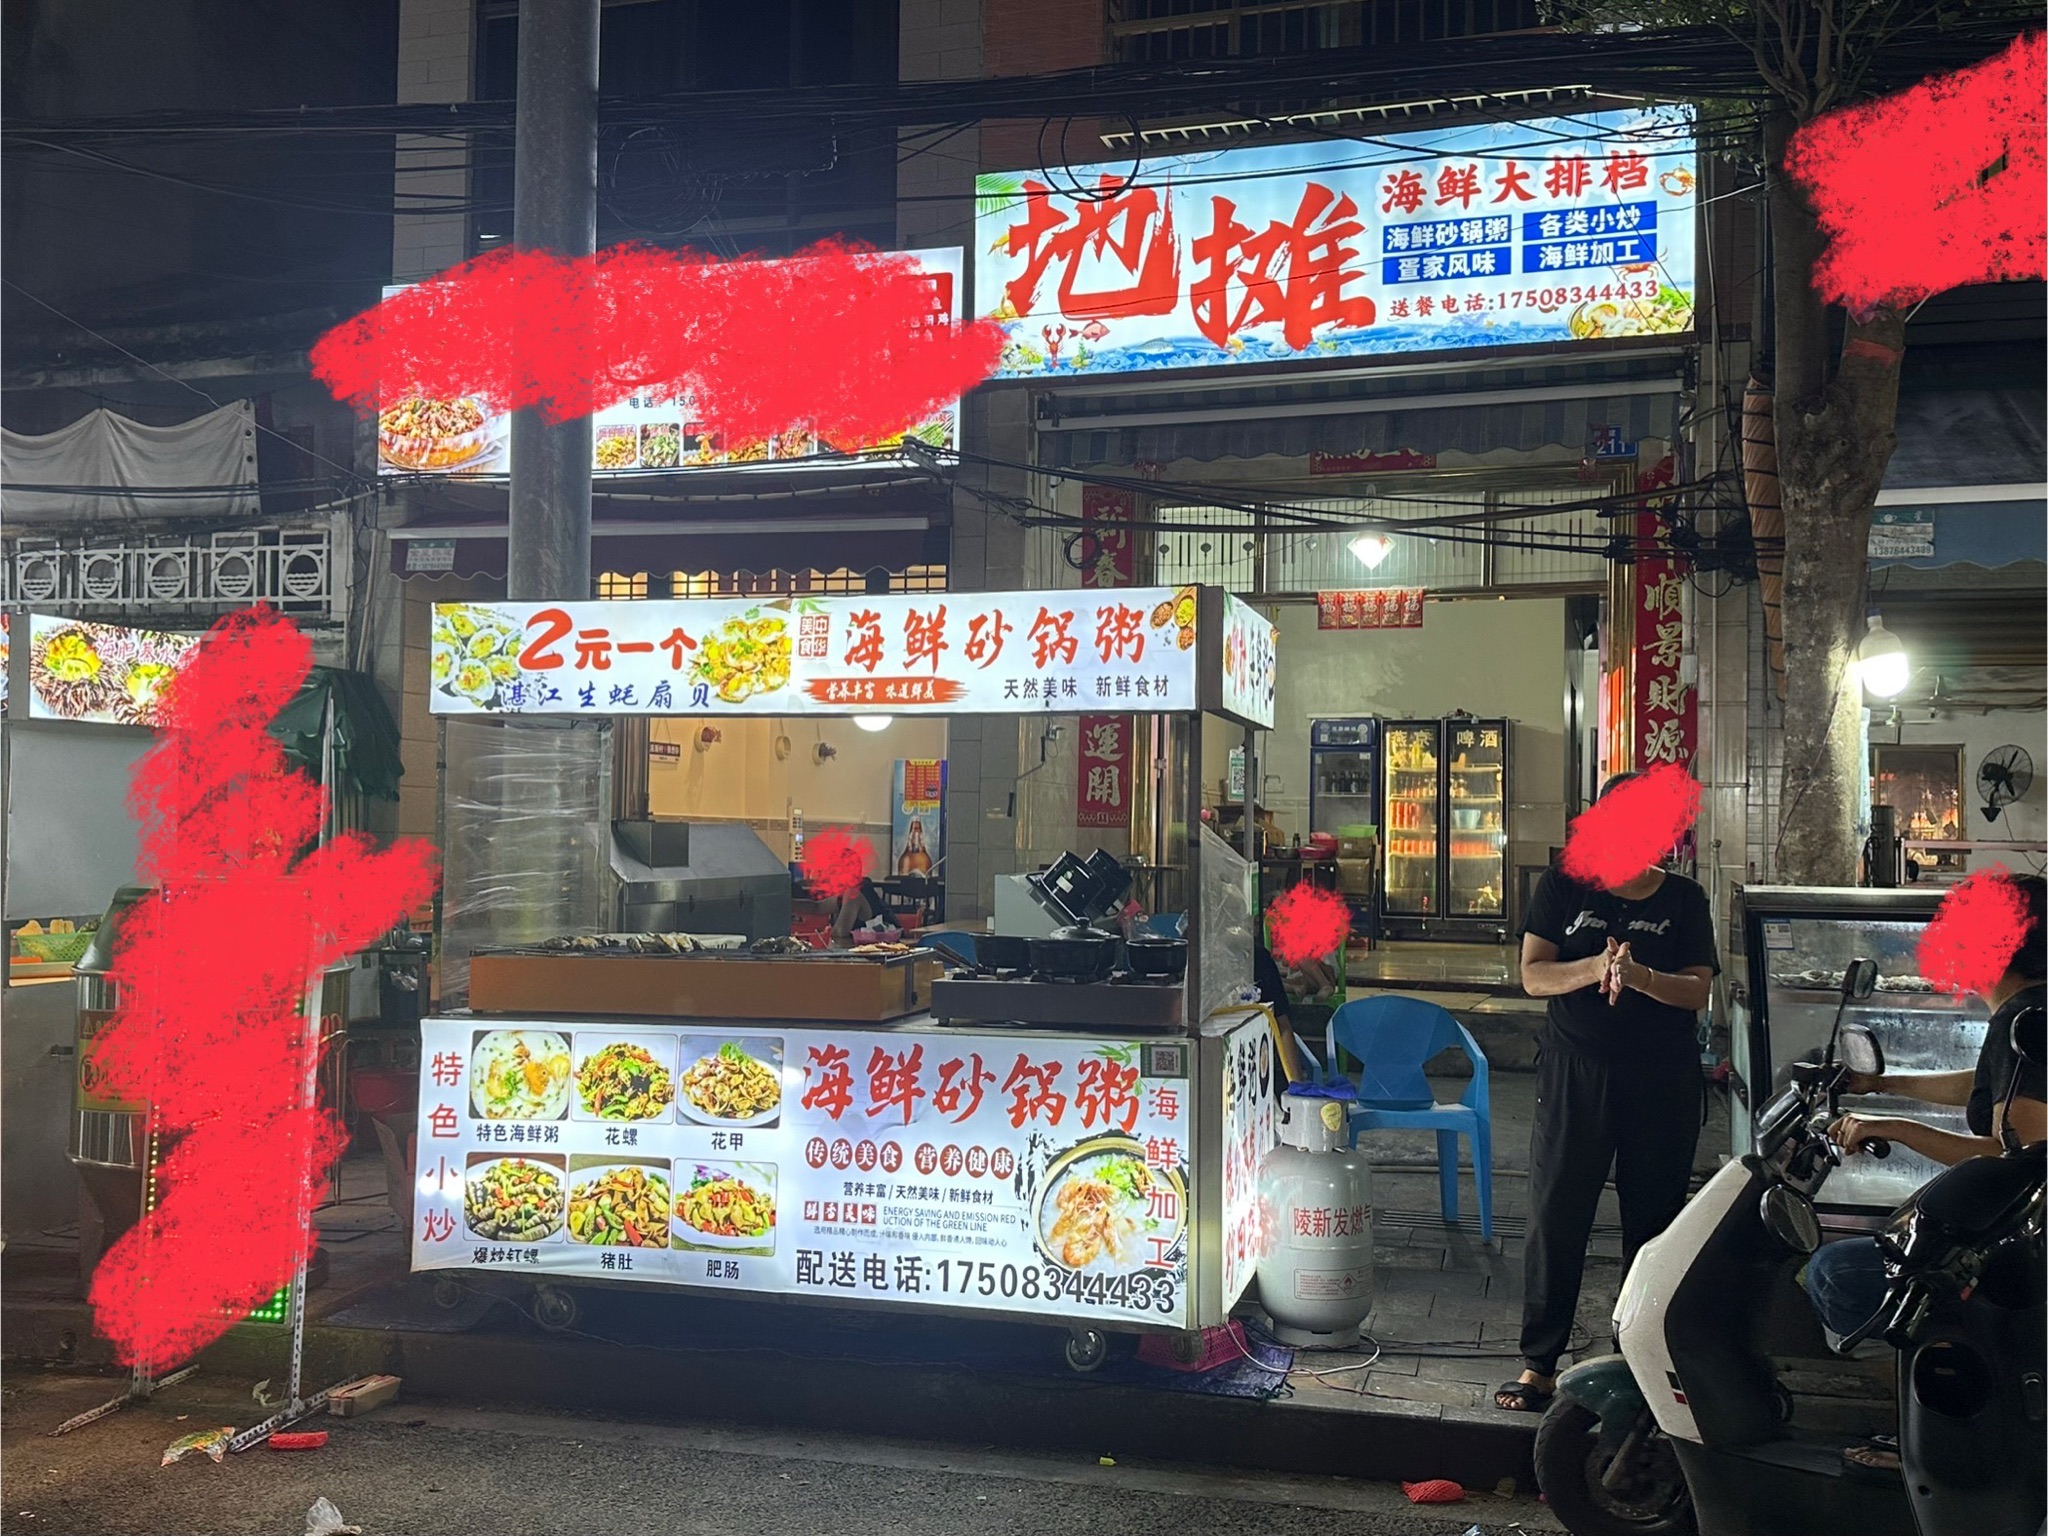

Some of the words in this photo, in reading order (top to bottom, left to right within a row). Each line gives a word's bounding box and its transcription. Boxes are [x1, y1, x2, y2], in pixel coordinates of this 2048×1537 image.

[1381, 148, 1650, 214] 海鲜大排档
[1386, 216, 1509, 252] 海鲜砂锅粥
[1538, 204, 1643, 238] 各类小炒
[1004, 172, 1377, 351] 地摊
[1538, 238, 1642, 270] 海鲜加工
[1389, 279, 1660, 320] 送餐电话:17508344433
[518, 608, 697, 670] 2元一个
[844, 602, 1146, 672] 海鲜砂锅粥
[1003, 677, 1079, 700] 天然美味
[1095, 674, 1170, 696] 新鲜食材
[1456, 730, 1498, 747] 啤酒
[801, 1042, 1141, 1133] 海鲜砂锅粥
[423, 1051, 464, 1242] 特色小炒
[476, 1124, 560, 1143] 特色海鲜粥
[604, 1127, 639, 1146] 花螺
[710, 1132, 744, 1151] 花甲
[805, 1138, 903, 1174] 传统美食
[914, 1142, 1015, 1181] 营养健康
[1143, 1085, 1180, 1270] 海鲜加工
[883, 1206, 913, 1216] ENERGY
[914, 1207, 942, 1218] SAVING
[944, 1209, 960, 1219] AND
[1000, 1214, 1016, 1224] RED
[914, 1219, 924, 1228] OF
[926, 1220, 941, 1229] THE
[942, 1220, 968, 1230] GREEN
[970, 1222, 988, 1232] LINE
[600, 1253, 634, 1270] 猪肚
[706, 1260, 740, 1280] 肥肠
[796, 1249, 1175, 1314] 配送电话:17508344433
